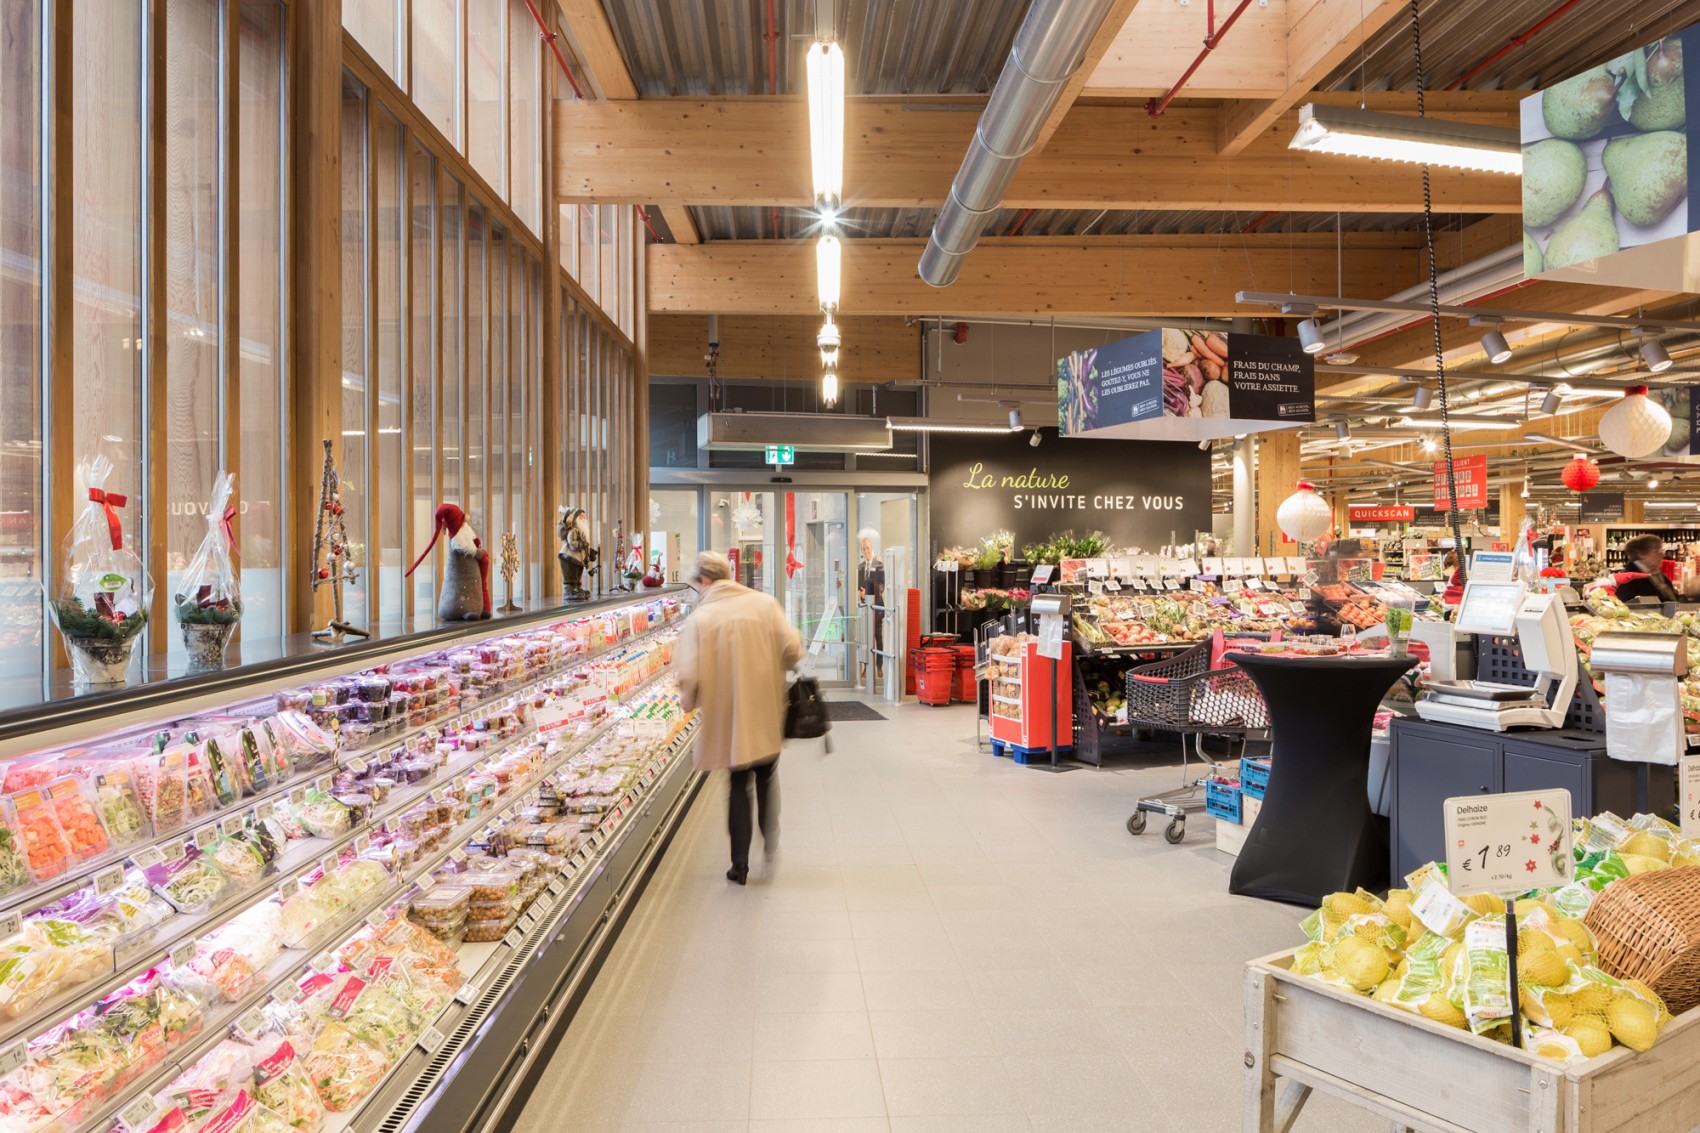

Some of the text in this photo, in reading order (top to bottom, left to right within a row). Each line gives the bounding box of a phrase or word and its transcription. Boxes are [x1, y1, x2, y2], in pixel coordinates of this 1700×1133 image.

[1101, 370, 1110, 378] LES
[1110, 364, 1134, 376] LÉGUMES
[1233, 361, 1257, 369] FRAIS
[1271, 363, 1301, 373] CHAMP,
[1127, 370, 1141, 380] VOUS
[1142, 369, 1150, 377] NE
[1258, 373, 1280, 381] DANS
[1111, 381, 1139, 394] OUBLIEREZ
[1139, 379, 1151, 387] PAS.
[1234, 382, 1300, 392] VOTRE ASSIETTE.
[963, 462, 1070, 489] La nature
[1014, 494, 1184, 510] S'INVITE CHEZ VOUS
[1355, 510, 1409, 518] QUICKSCAN
[1457, 805, 1488, 815] Delhaize
[1462, 844, 1511, 871] € 1 89
